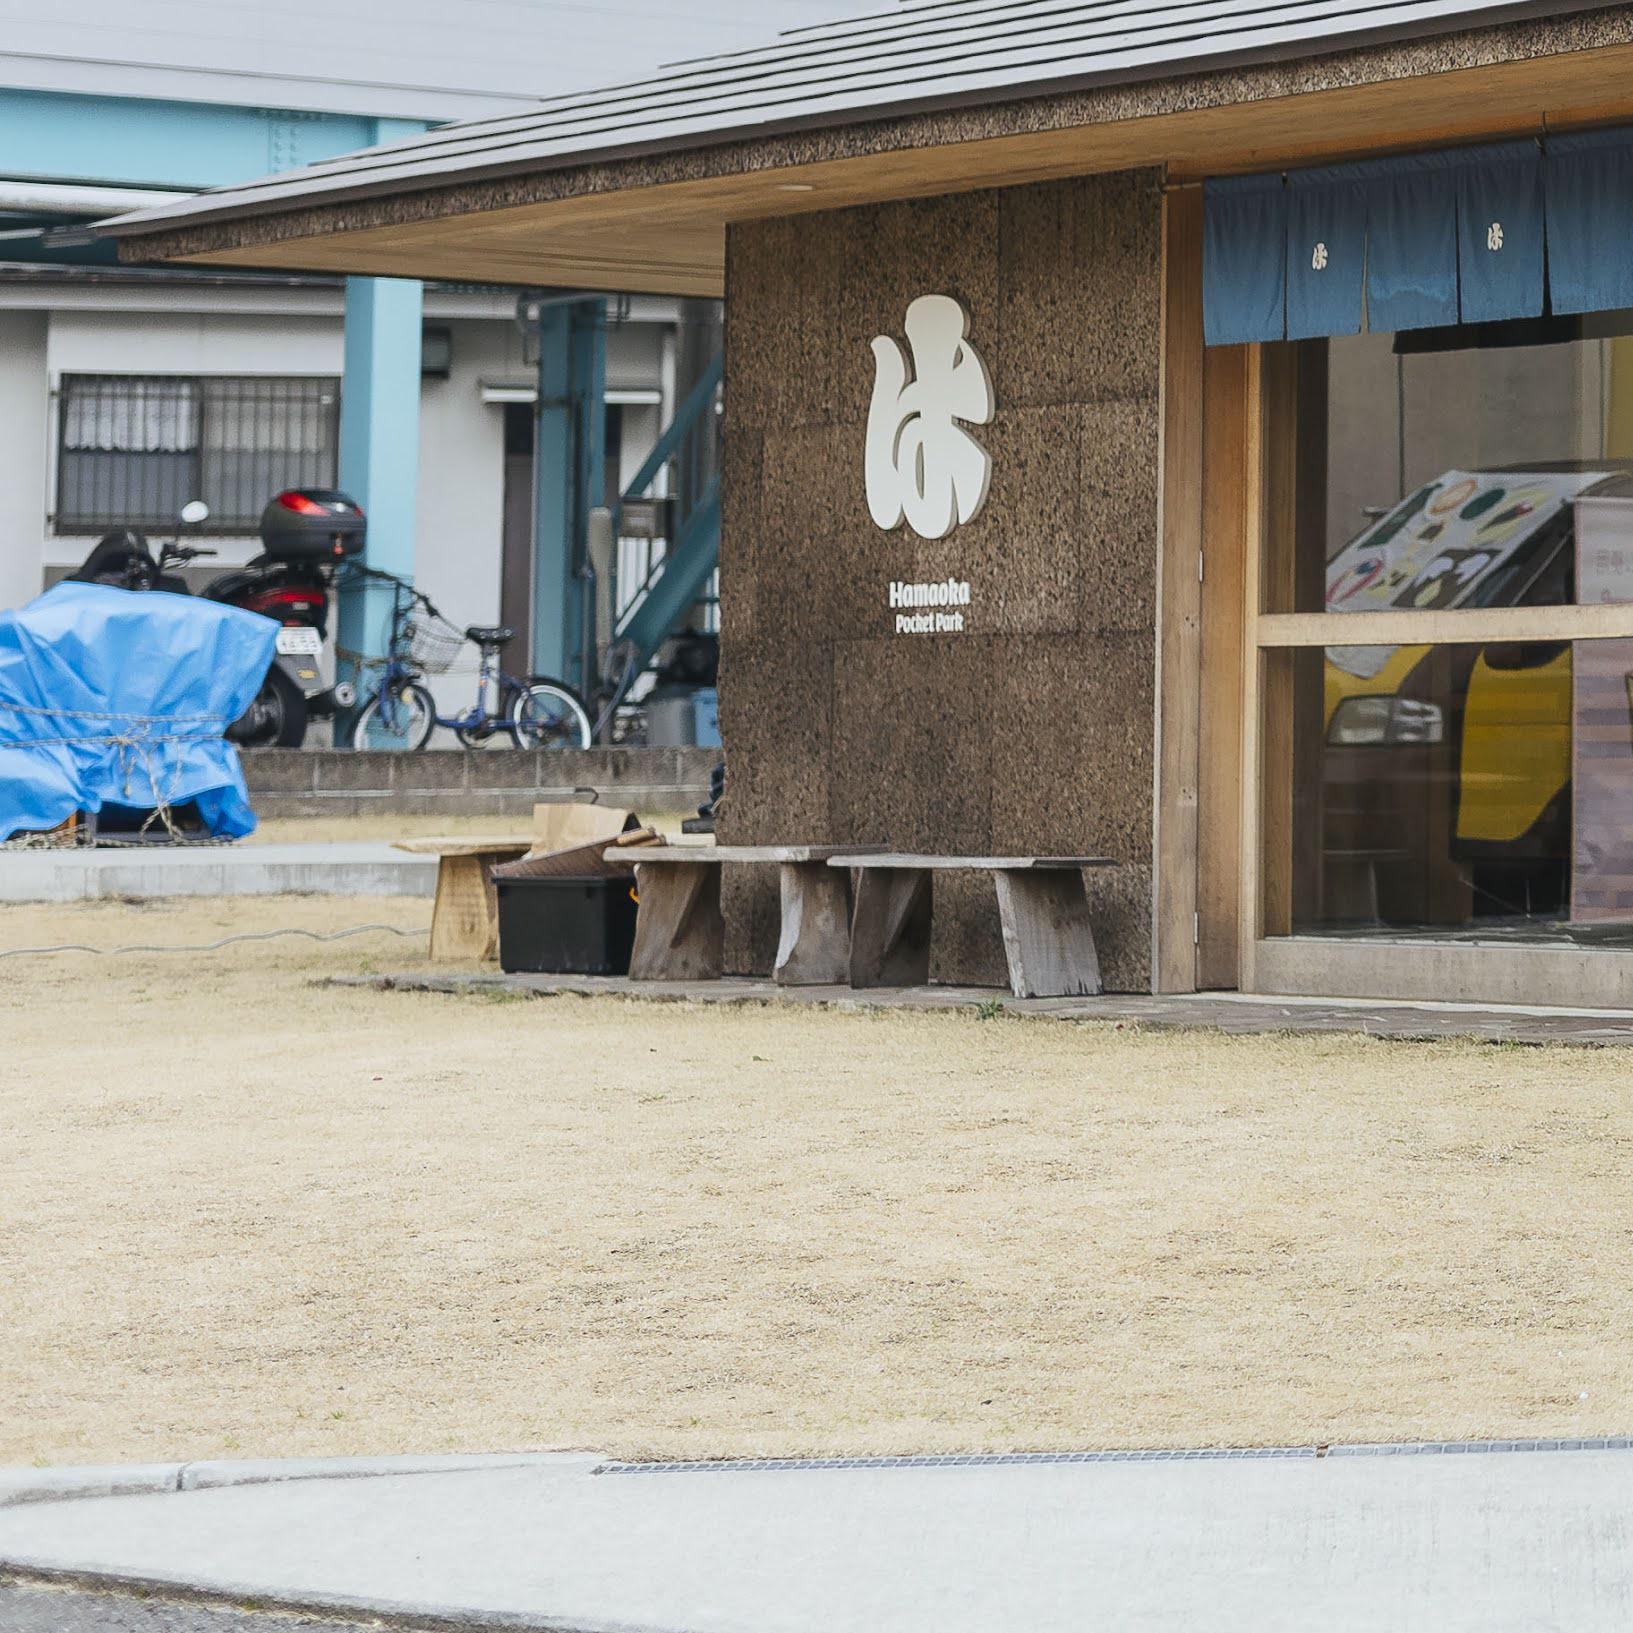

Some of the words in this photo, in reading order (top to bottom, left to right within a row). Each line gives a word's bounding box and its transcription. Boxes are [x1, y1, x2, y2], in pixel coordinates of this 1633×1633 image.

[889, 577, 971, 608] Hamaoka
[896, 611, 935, 634] Pocket
[936, 611, 964, 632] Park
